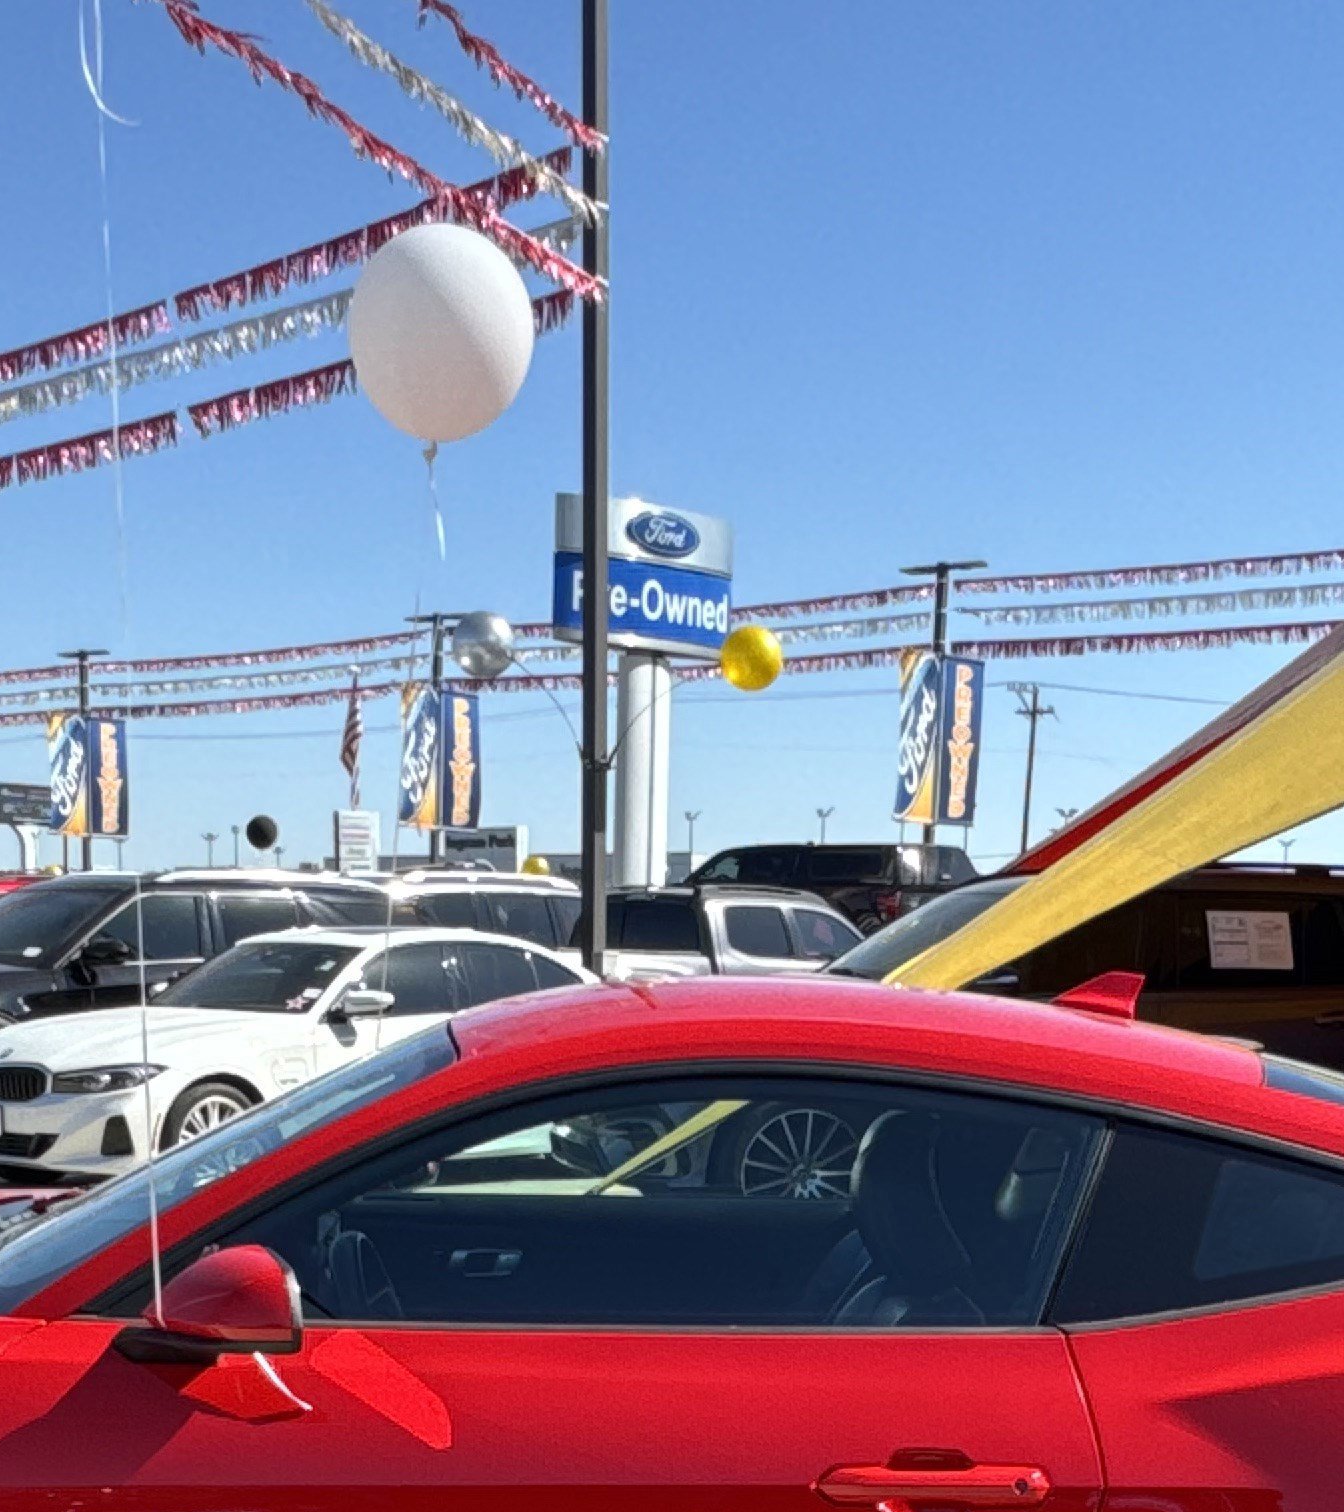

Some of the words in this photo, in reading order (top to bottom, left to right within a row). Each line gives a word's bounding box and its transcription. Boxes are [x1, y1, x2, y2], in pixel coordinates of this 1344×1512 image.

[644, 518, 687, 548] Ford
[572, 570, 728, 633] Pe-Owned
[51, 737, 84, 815] Ford
[401, 715, 436, 803] Ford
[898, 684, 937, 794] Ford
